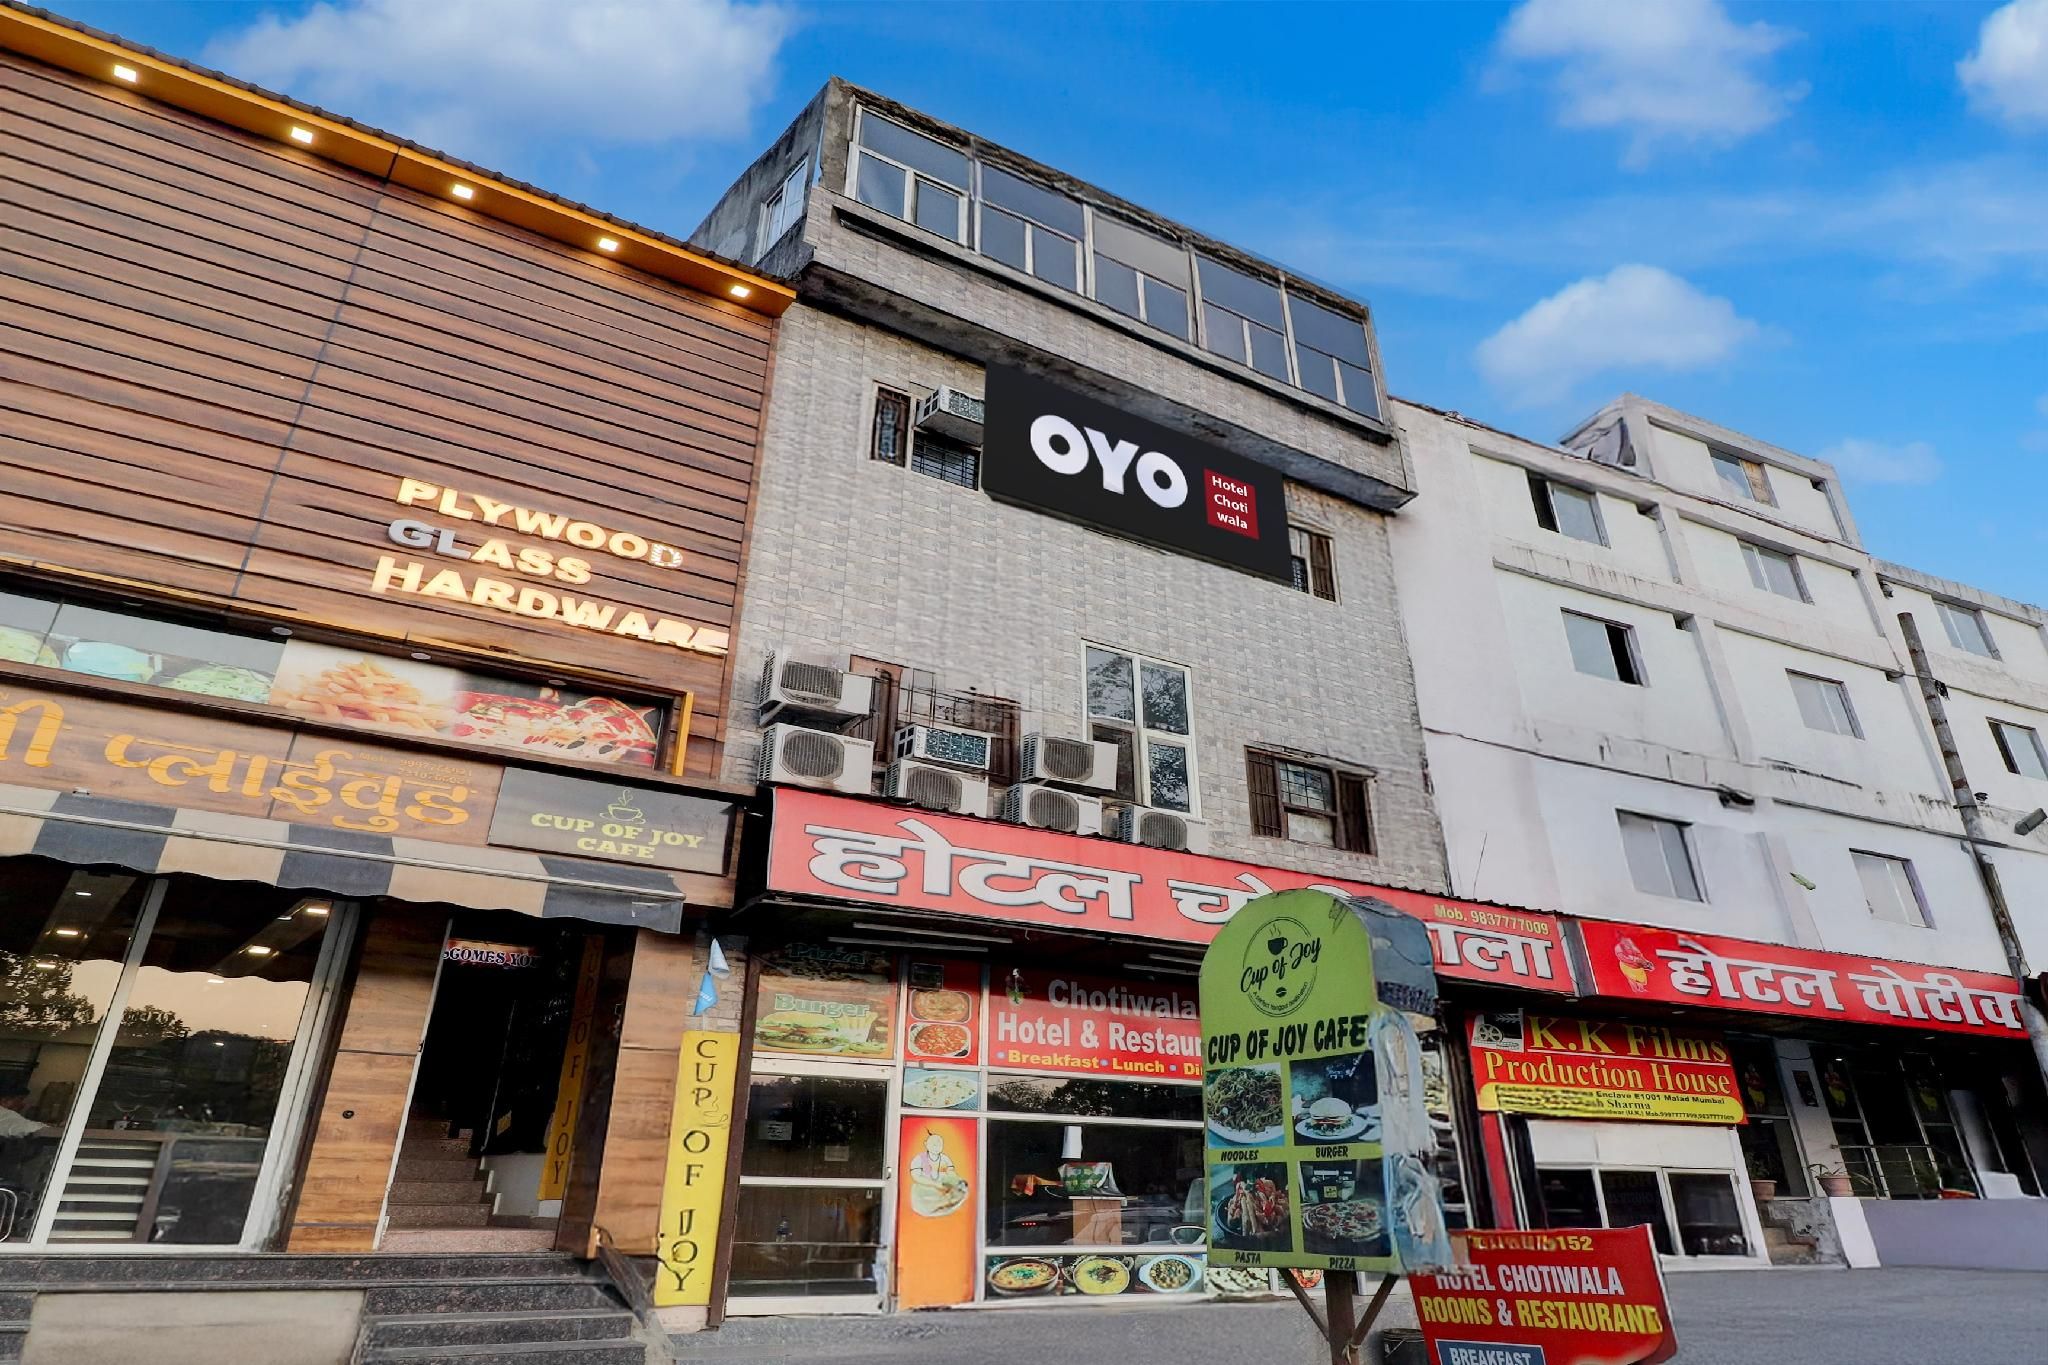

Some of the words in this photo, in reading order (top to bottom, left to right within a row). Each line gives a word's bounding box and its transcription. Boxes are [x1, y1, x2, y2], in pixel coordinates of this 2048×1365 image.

[1030, 414, 1188, 508] OYO
[1211, 475, 1248, 497] Hotel
[1213, 493, 1248, 514] Choti
[396, 477, 683, 569] PLYWOOD
[1216, 510, 1248, 530] wala
[388, 519, 592, 585] GLASS
[531, 812, 595, 833] CUP
[601, 823, 644, 840] OF
[648, 829, 705, 849] JOY
[576, 837, 655, 859] CAFE
[804, 819, 1142, 921] होटल
[1434, 903, 1468, 922] Mob.
[1470, 910, 1550, 936] 9837777009
[1241, 966, 1268, 993] Cup
[1272, 957, 1287, 980] of
[1290, 937, 1322, 969] Joy
[1656, 933, 1845, 1012] होटल
[775, 994, 870, 1018] Burger
[1048, 979, 1197, 1020] Chotiwala
[998, 1012, 1070, 1047] Hotel
[1080, 1019, 1100, 1049] &
[1208, 1033, 1241, 1065] CUP
[1246, 1029, 1269, 1060] OF
[1273, 1023, 1308, 1057] JOY
[1313, 1014, 1369, 1053] CAFE
[1527, 1016, 1616, 1054] K.K
[1621, 1024, 1728, 1063] Films
[692, 1039, 719, 1107] CUP
[1008, 1050, 1100, 1069] Breakfast
[1112, 1057, 1165, 1073] Lunch
[1484, 1051, 1644, 1089] Production
[1652, 1063, 1732, 1094] House
[1597, 1090, 1632, 1100] Enclave
[1664, 1094, 1690, 1103] Malad
[1692, 1097, 1725, 1105] Mumbai
[1607, 1099, 1651, 1110] Sharma
[553, 1101, 571, 1185] JOY
[683, 1130, 710, 1187] OF
[1220, 1150, 1260, 1162] NOODLES
[1315, 1146, 1349, 1159] BURGER
[671, 1209, 698, 1292] JOY
[1235, 1252, 1261, 1265] PASTA
[1329, 1257, 1356, 1270] PIZZA
[1499, 1264, 1625, 1296] CHOTIWALA
[1420, 1296, 1493, 1326] ROOMS
[1497, 1298, 1514, 1326] &
[1448, 1347, 1532, 1365] BREAKFAST
